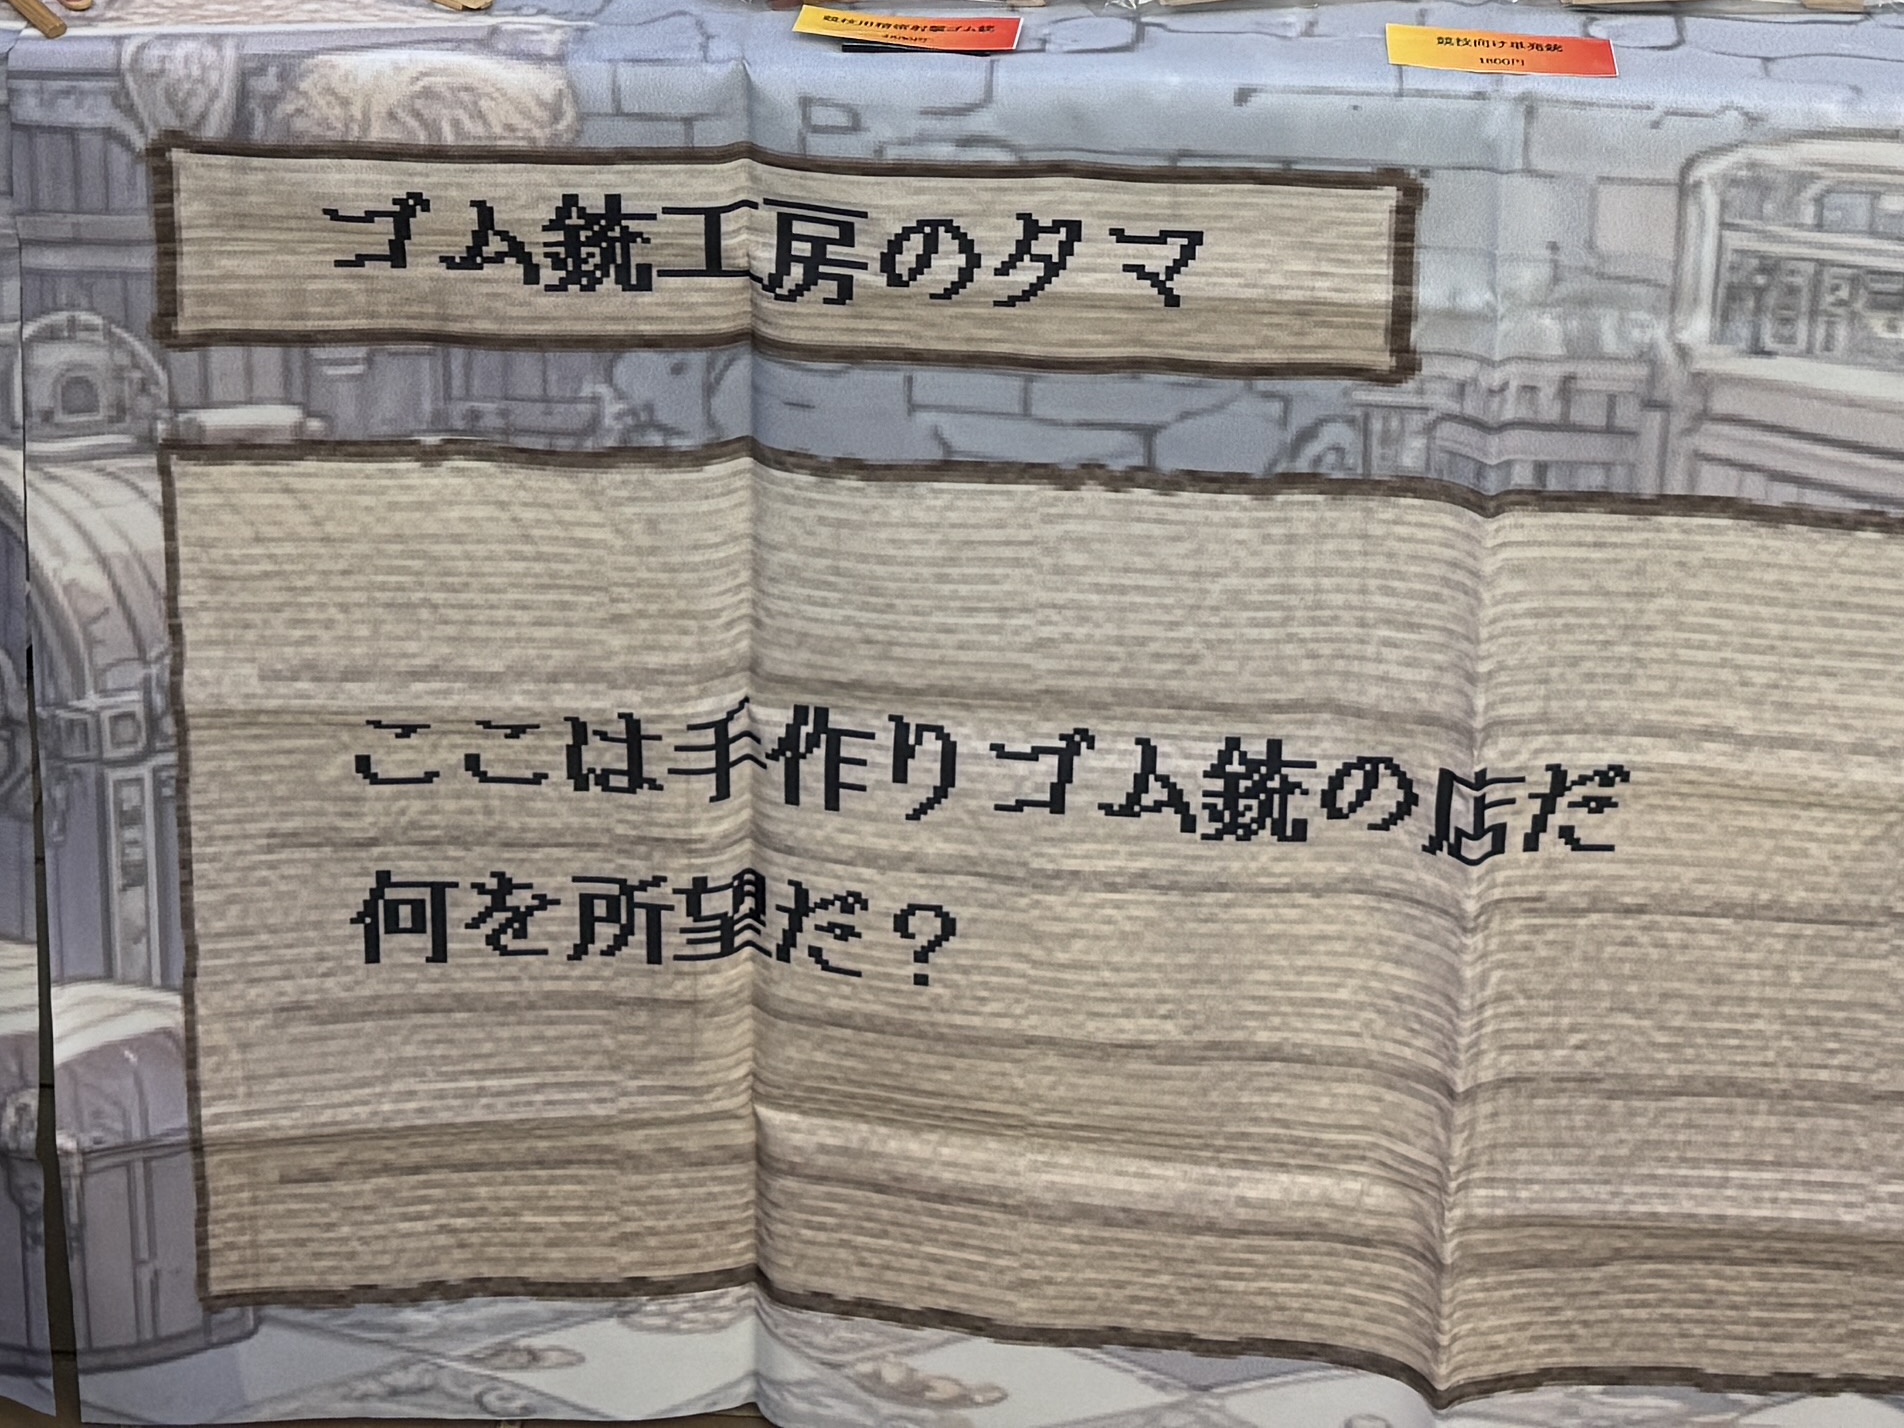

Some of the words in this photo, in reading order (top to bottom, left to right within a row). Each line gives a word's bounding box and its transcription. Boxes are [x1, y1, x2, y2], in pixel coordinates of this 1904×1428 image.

[322, 191, 1205, 309] ゴム銃工房のタマ
[355, 696, 1632, 866] ここは手作りゴム銃の店だ
[350, 868, 960, 987] 何を所望だ?
